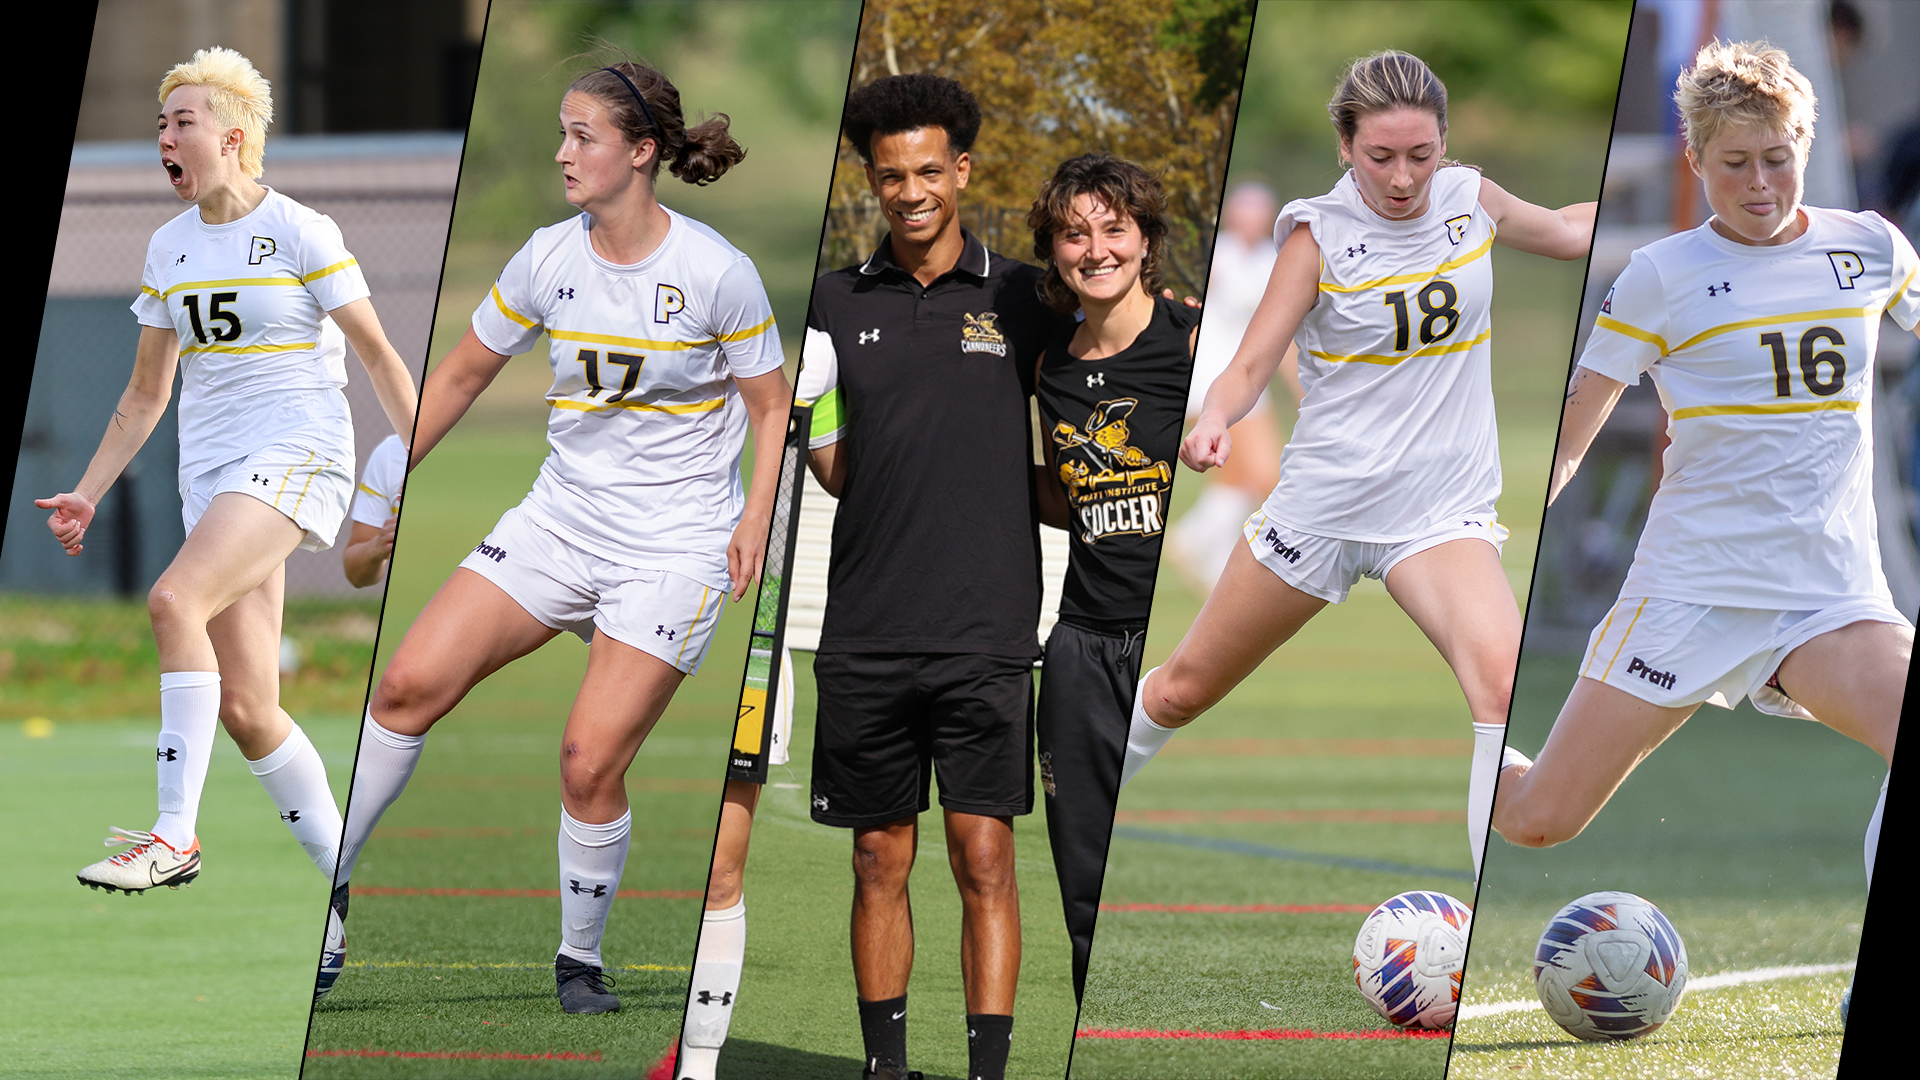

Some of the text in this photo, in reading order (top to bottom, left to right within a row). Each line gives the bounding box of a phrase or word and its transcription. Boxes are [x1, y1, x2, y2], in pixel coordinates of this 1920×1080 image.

[248, 236, 276, 265] P
[1826, 251, 1865, 290] P
[182, 291, 242, 344] 15
[654, 283, 685, 324] P
[1383, 279, 1461, 352] 18
[576, 348, 647, 403] 17
[1759, 325, 1846, 398] 16
[1078, 482, 1158, 503] PRATT INSTITUTE
[1081, 494, 1162, 543] SOCCER
[1265, 527, 1301, 564] Pratt
[1626, 656, 1676, 691] Pratt
